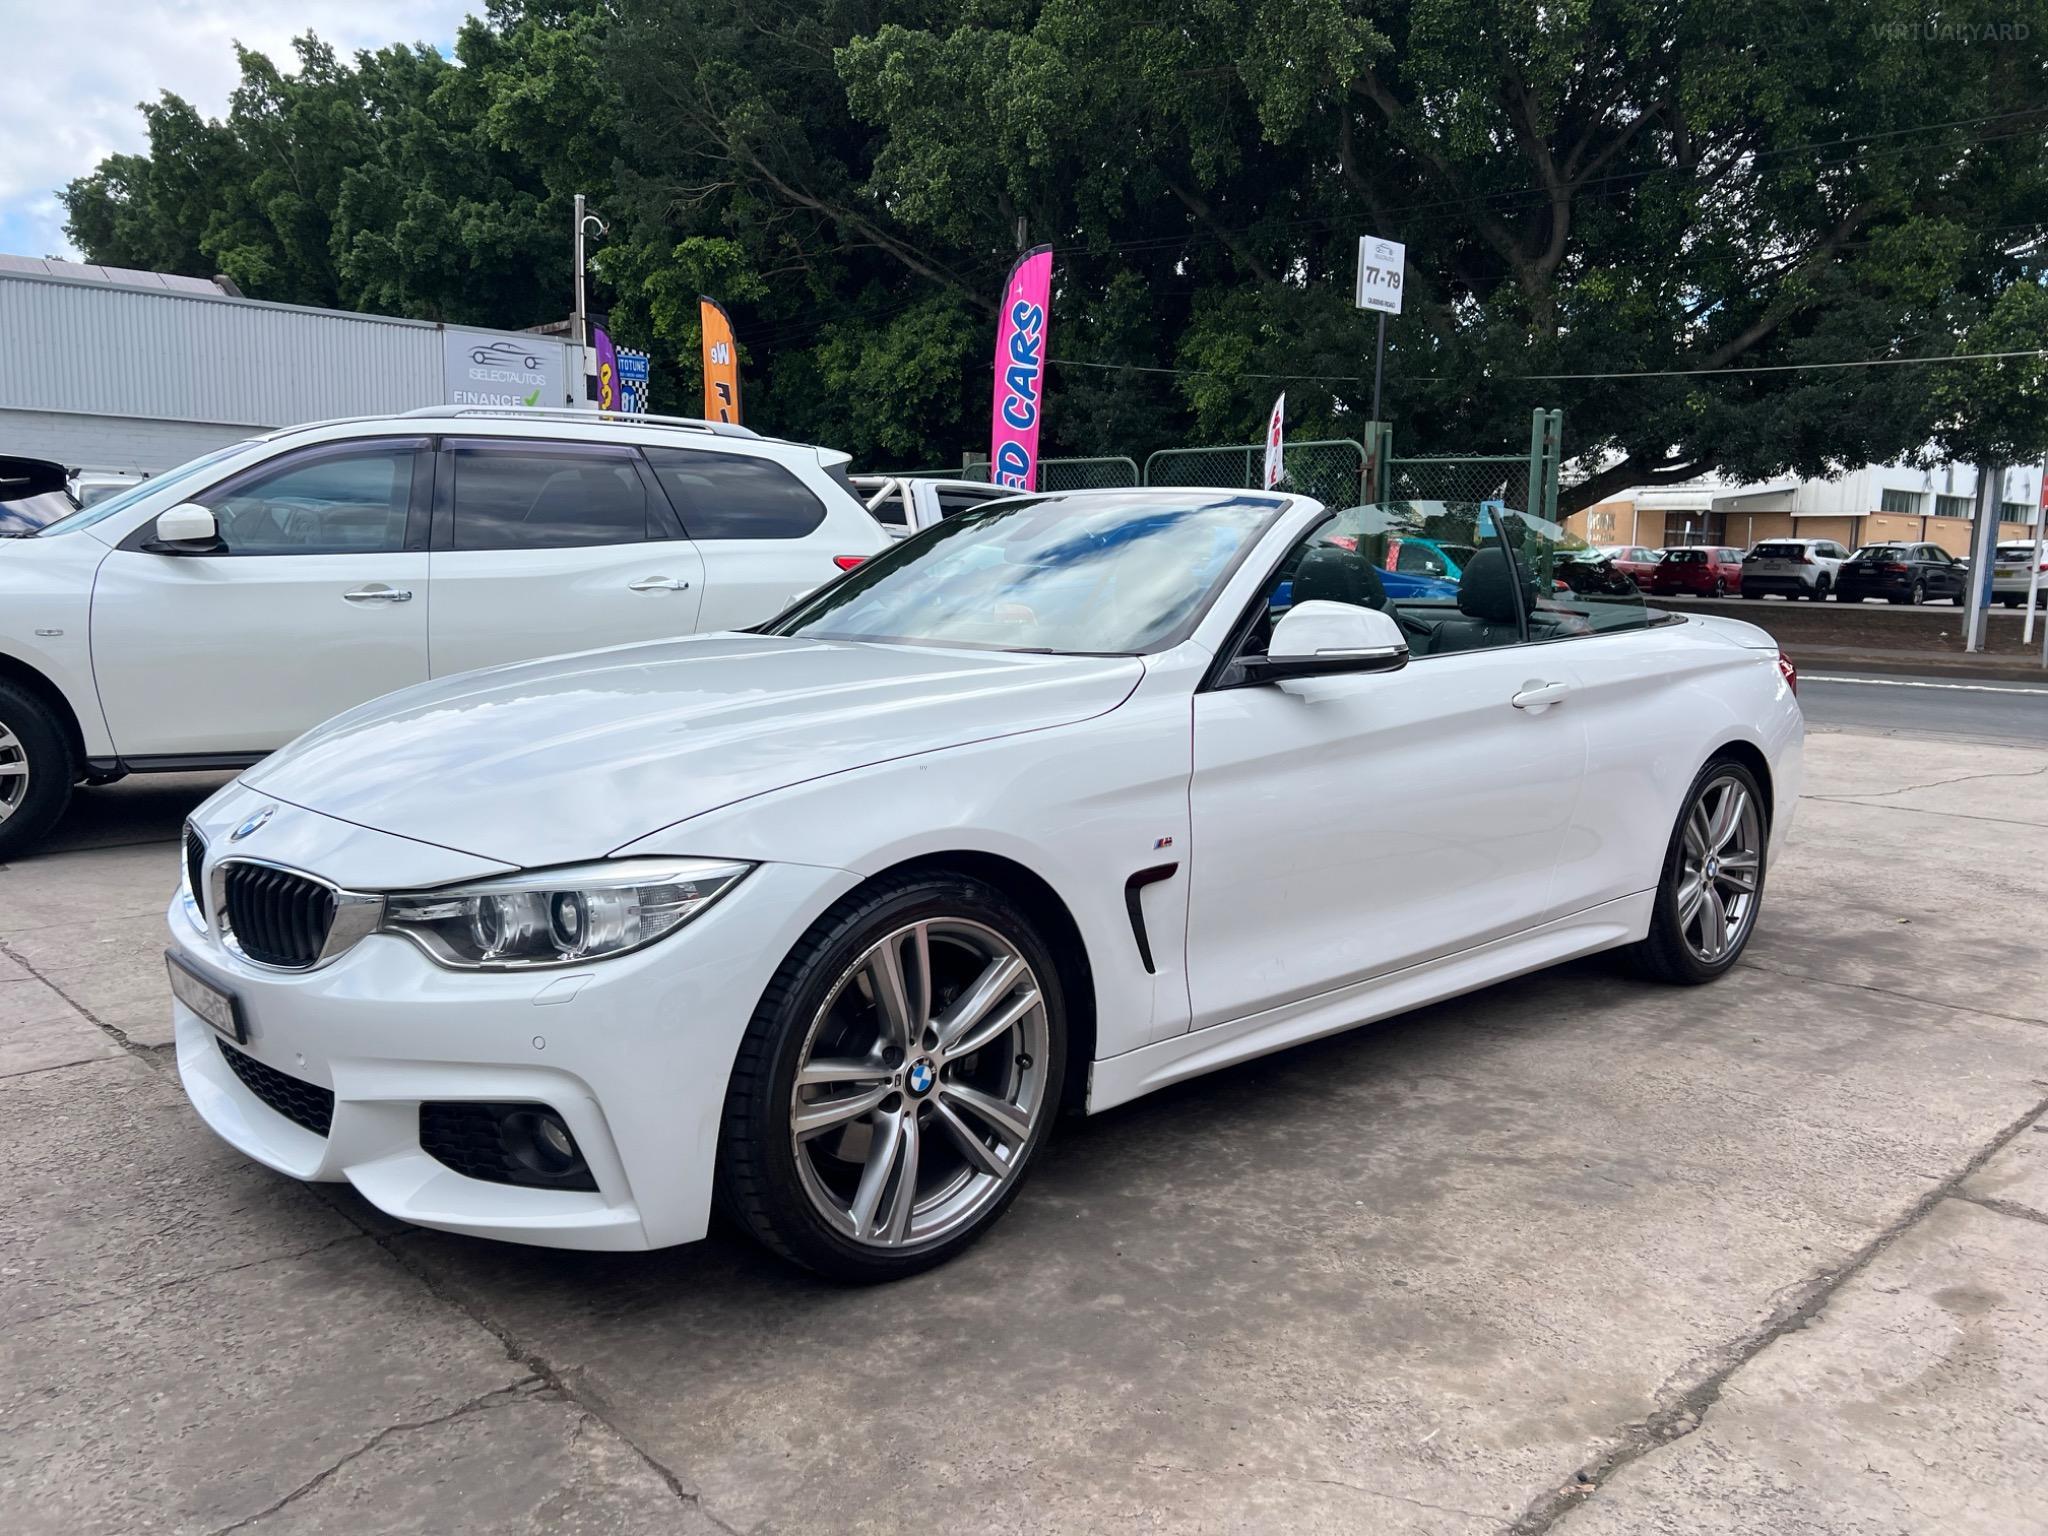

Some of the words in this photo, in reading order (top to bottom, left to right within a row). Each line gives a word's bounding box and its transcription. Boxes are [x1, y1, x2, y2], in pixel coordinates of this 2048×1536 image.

[1366, 266, 1400, 289] 77-79
[618, 358, 645, 373] TOTUNE
[1002, 300, 1043, 430] CARS
[469, 368, 546, 385] ISELECTAUTOS
[454, 391, 521, 406] FINANCE
